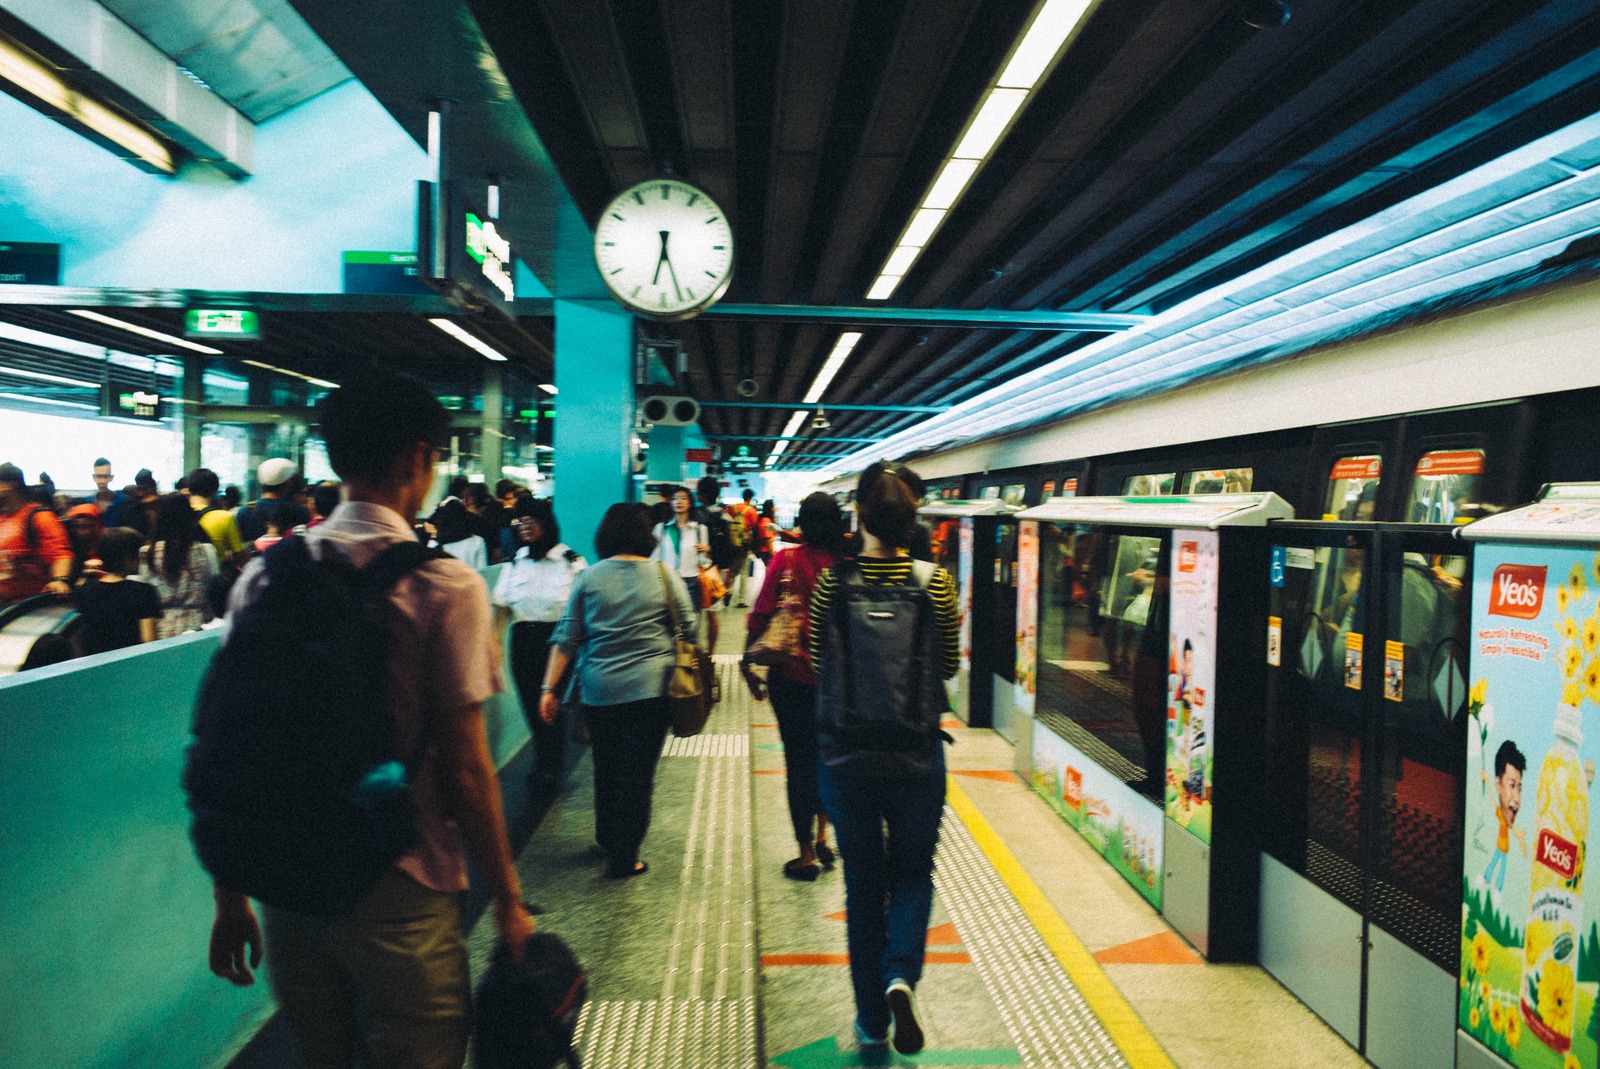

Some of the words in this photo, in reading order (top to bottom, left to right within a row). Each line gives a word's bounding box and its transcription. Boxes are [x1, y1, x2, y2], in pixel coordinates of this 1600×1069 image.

[1498, 573, 1539, 607] Yeo's
[1478, 626, 1509, 642] Naturally
[1481, 643, 1502, 657] Simply
[1543, 835, 1572, 871] Yeo's
